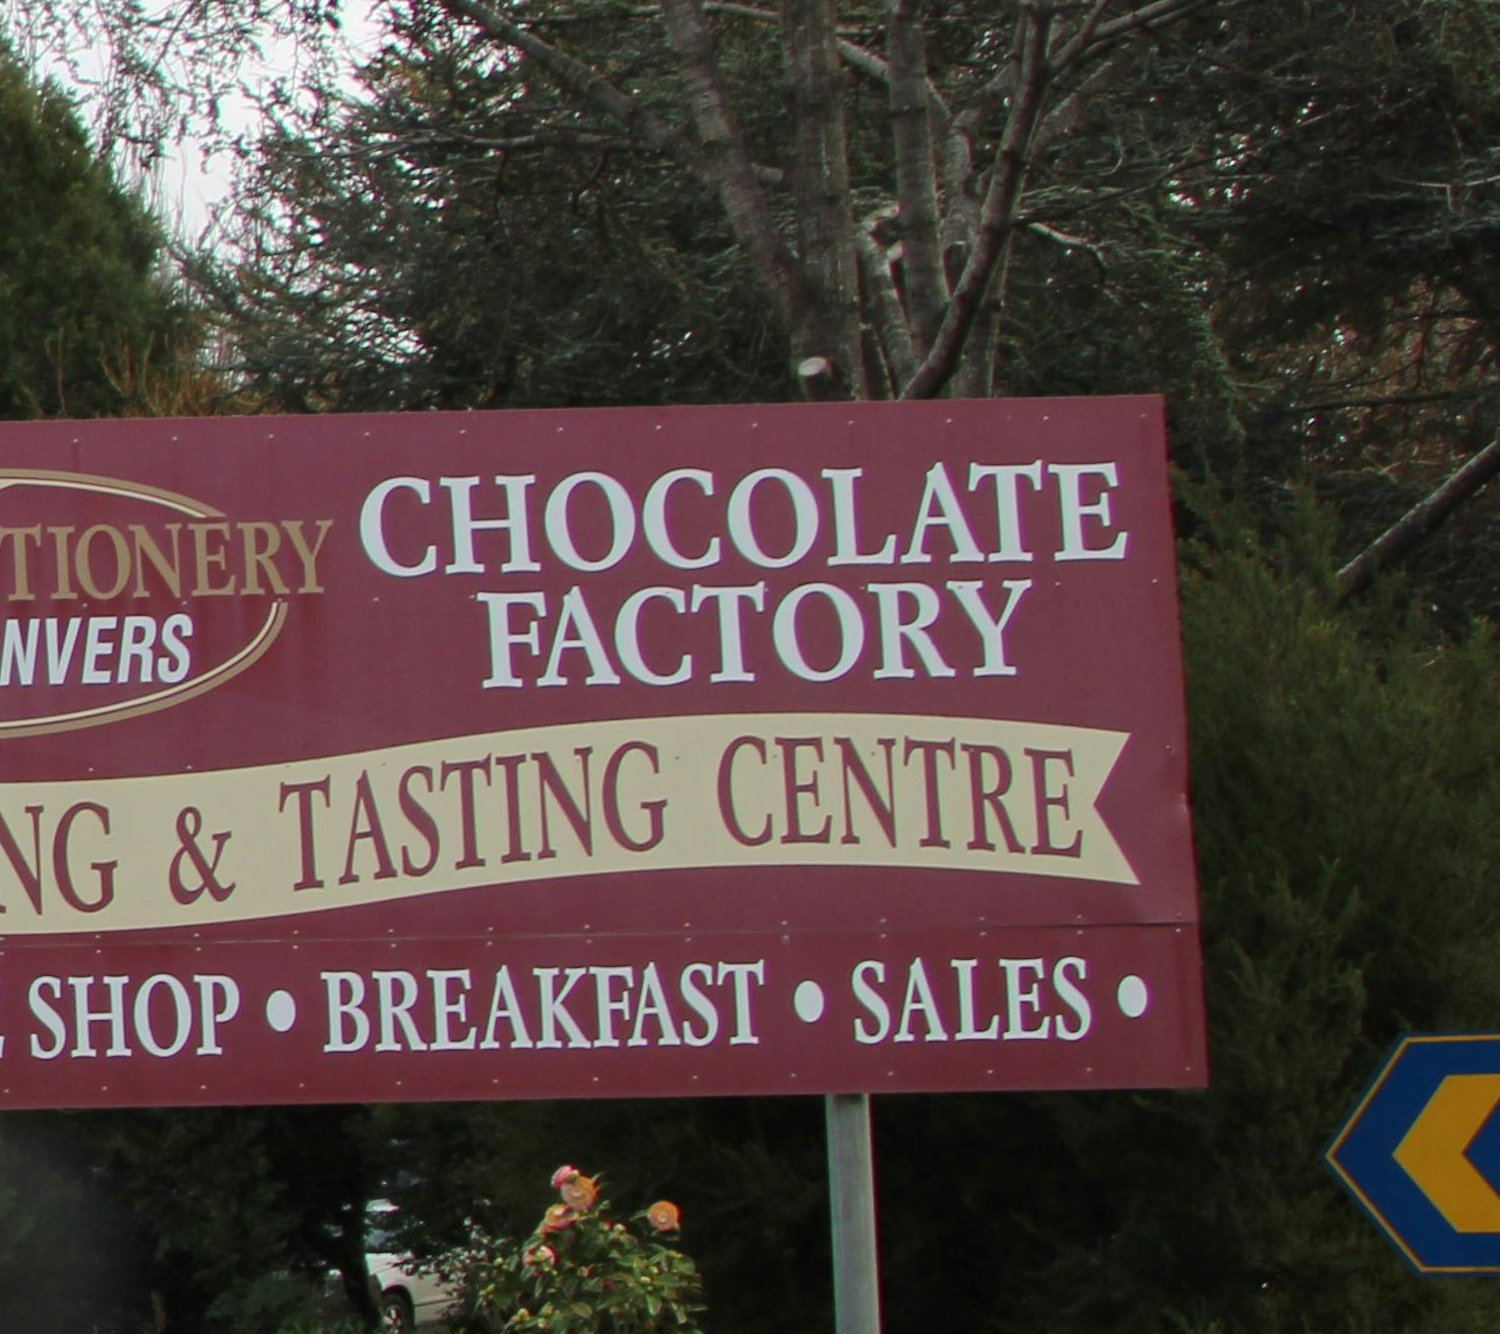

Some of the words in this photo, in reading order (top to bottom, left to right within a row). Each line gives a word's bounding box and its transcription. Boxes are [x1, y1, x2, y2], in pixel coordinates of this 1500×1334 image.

[358, 460, 1128, 577] CHOCOLATE
[476, 578, 1033, 689] FACTORY
[167, 805, 237, 906] &
[278, 739, 669, 892] TASTING
[716, 735, 1084, 859] CENTRE
[27, 973, 241, 1060] SHOP
[320, 958, 765, 1054] BREAKFAST
[850, 956, 1094, 1046] SALES
